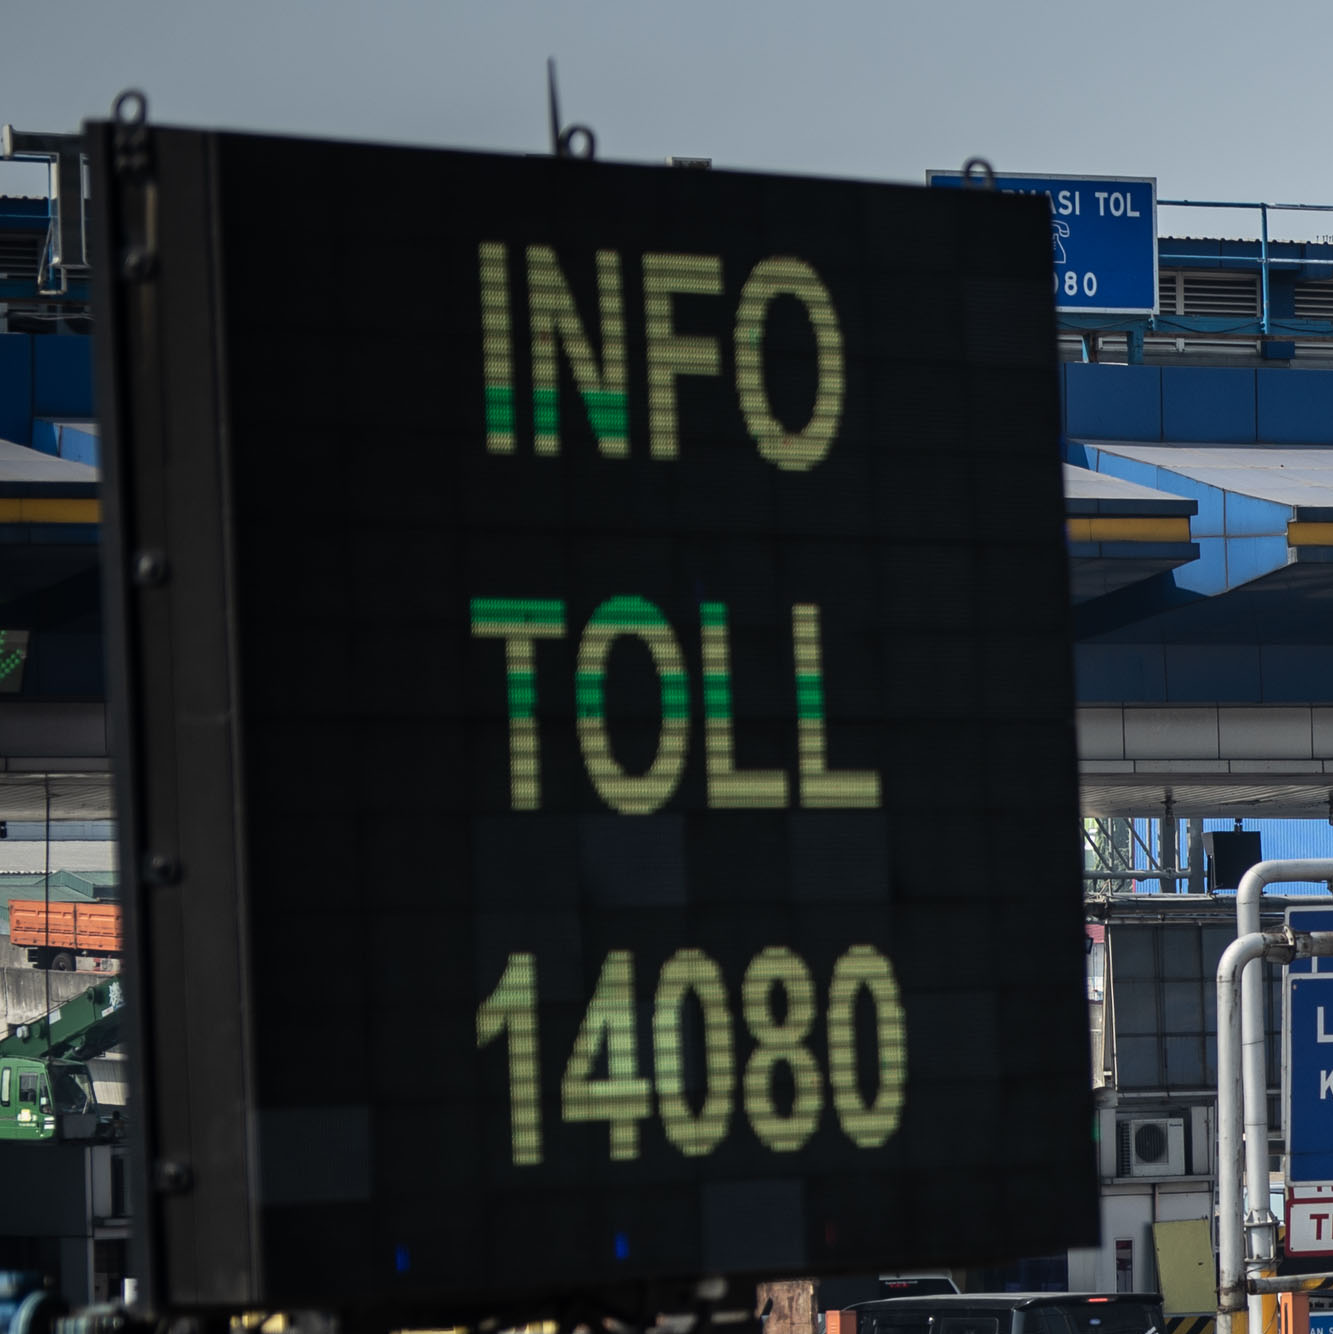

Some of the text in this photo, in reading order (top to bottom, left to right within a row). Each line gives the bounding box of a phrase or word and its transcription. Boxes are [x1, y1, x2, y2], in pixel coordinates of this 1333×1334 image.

[1095, 192, 1139, 216] TOL
[478, 242, 845, 471] INFO
[469, 594, 882, 815] TOLL
[476, 945, 908, 1168] 14080
